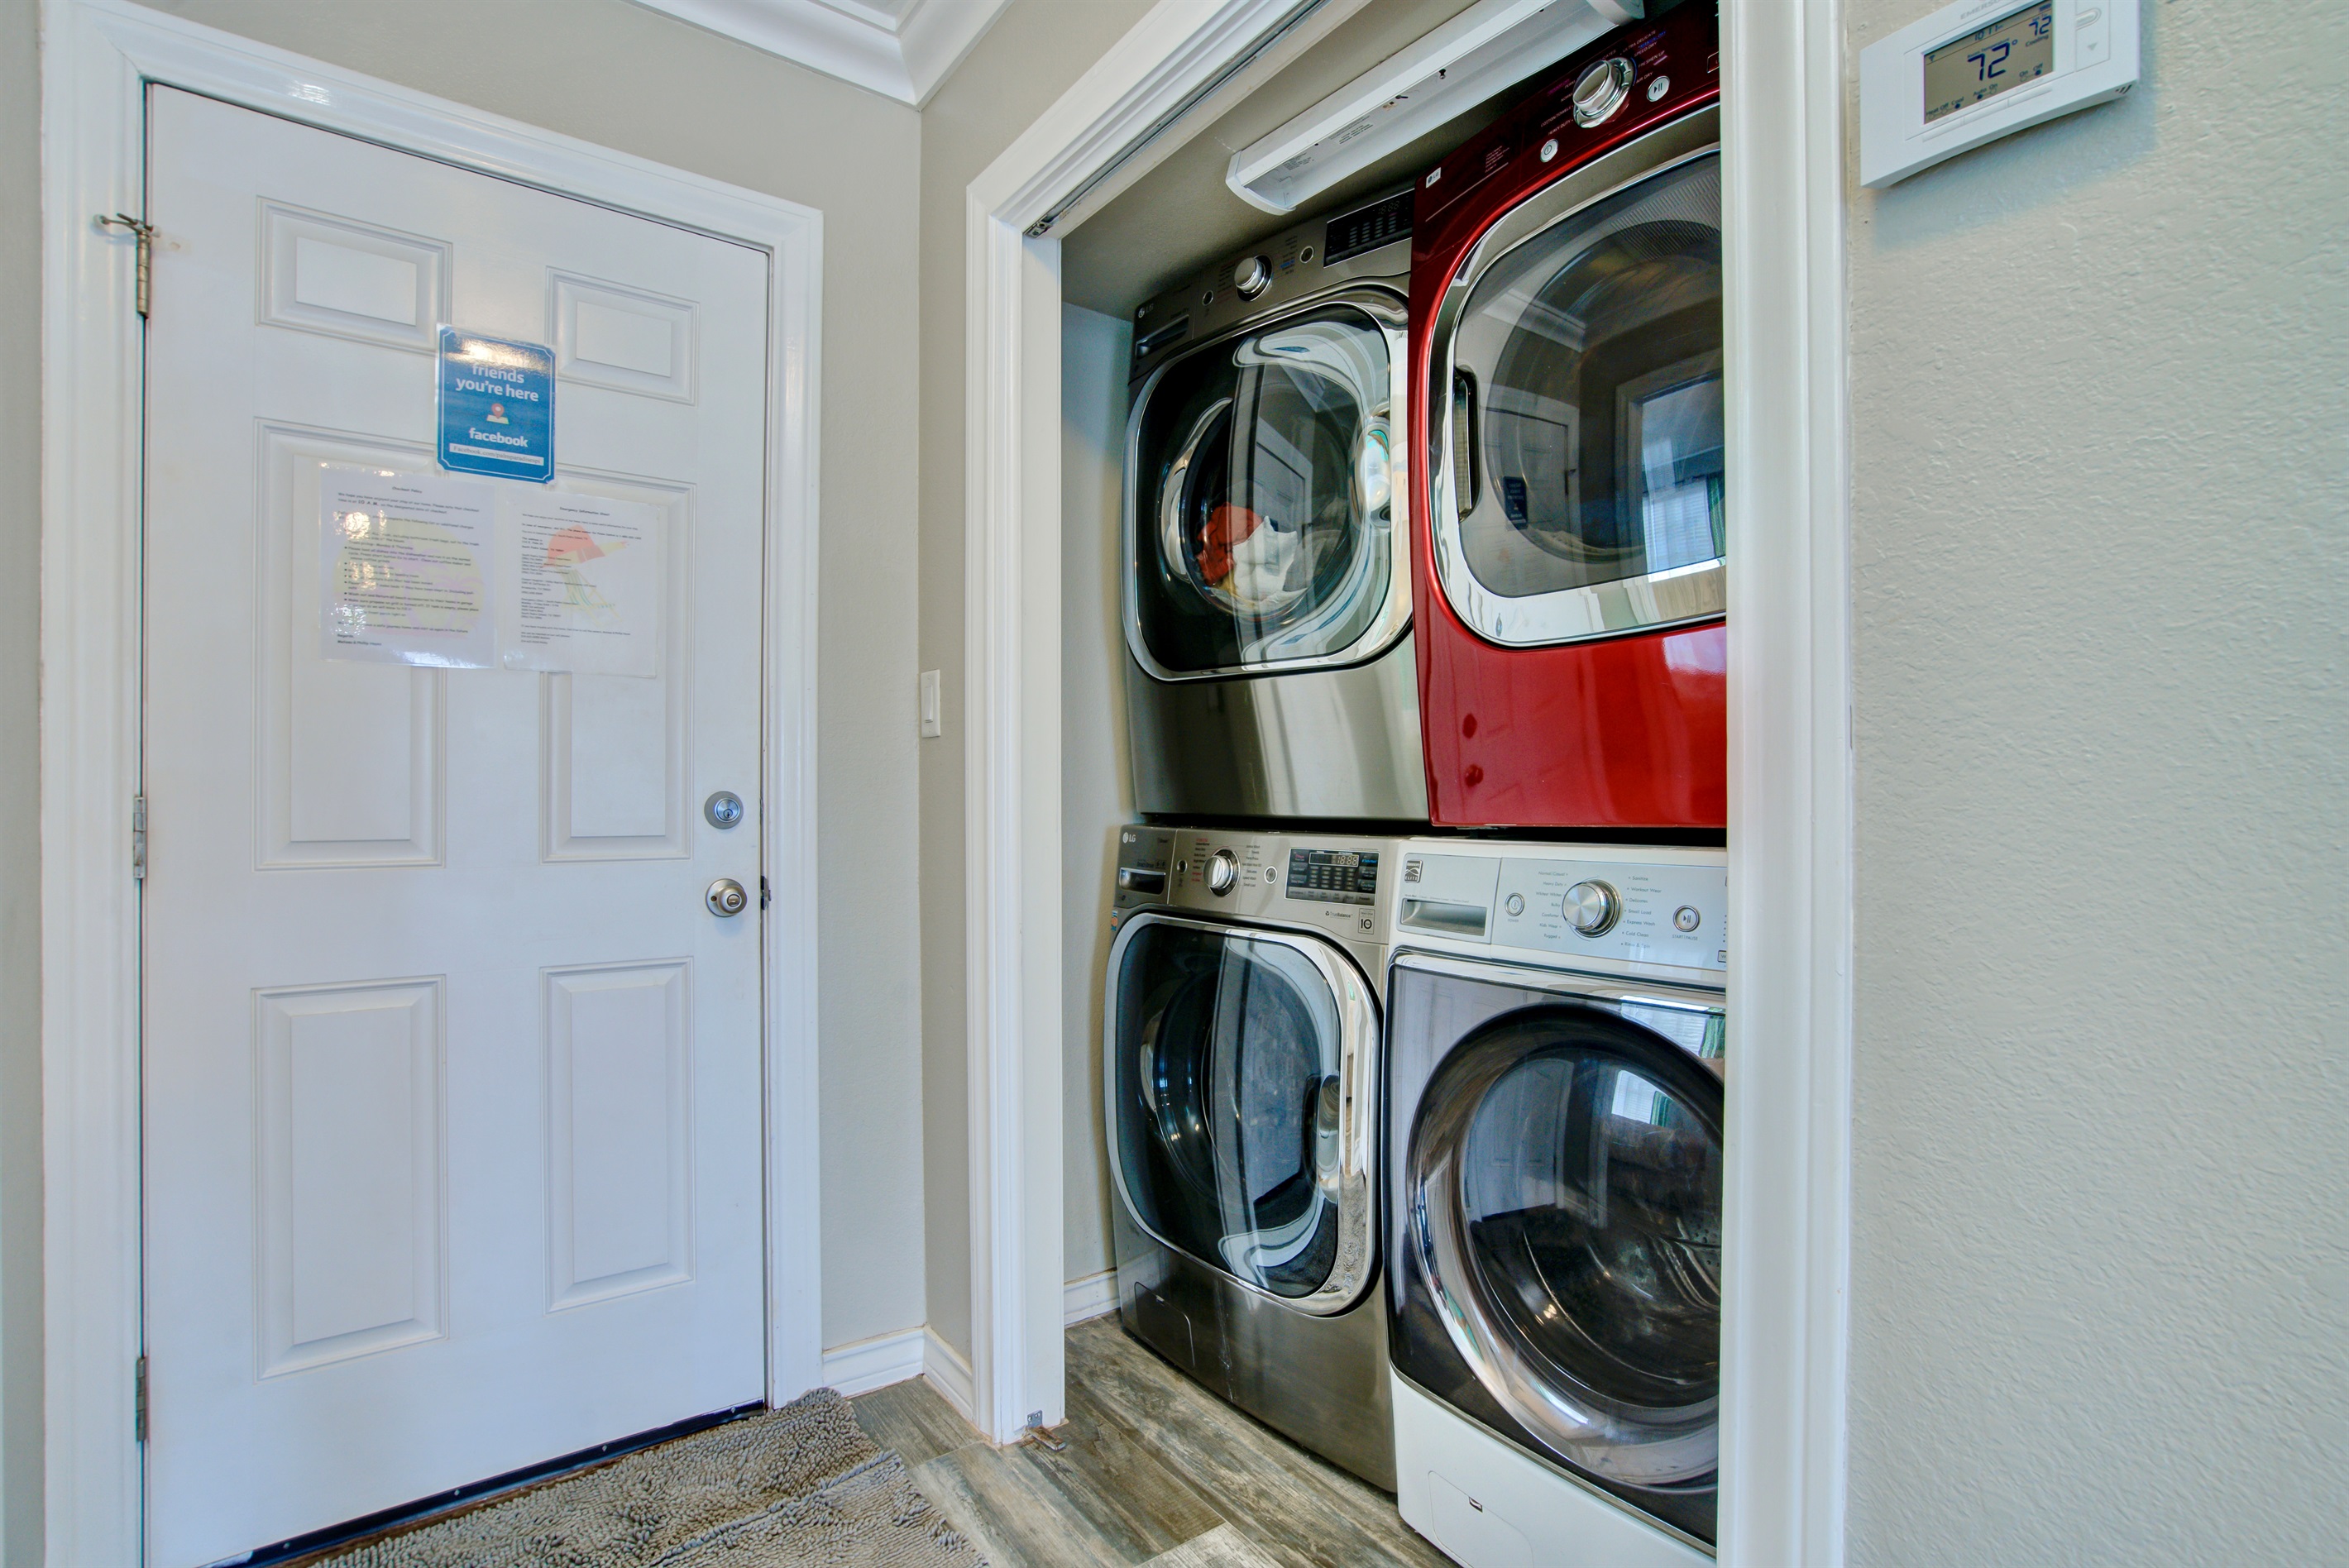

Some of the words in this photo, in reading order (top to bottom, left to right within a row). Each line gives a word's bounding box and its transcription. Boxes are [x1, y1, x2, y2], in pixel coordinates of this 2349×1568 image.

[2028, 15, 2052, 36] 72
[2026, 34, 2049, 47] Cooling
[1639, 55, 1658, 68] FRESHEN
[2019, 69, 2029, 78] On
[2033, 63, 2043, 72] Off
[1973, 88, 1987, 96] Auto
[1940, 102, 1949, 110] Off
[1951, 97, 1964, 106] Cool
[472, 364, 524, 384] friends
[505, 384, 538, 402] here
[469, 427, 529, 447] facebook
[1361, 918, 1372, 930] 10
